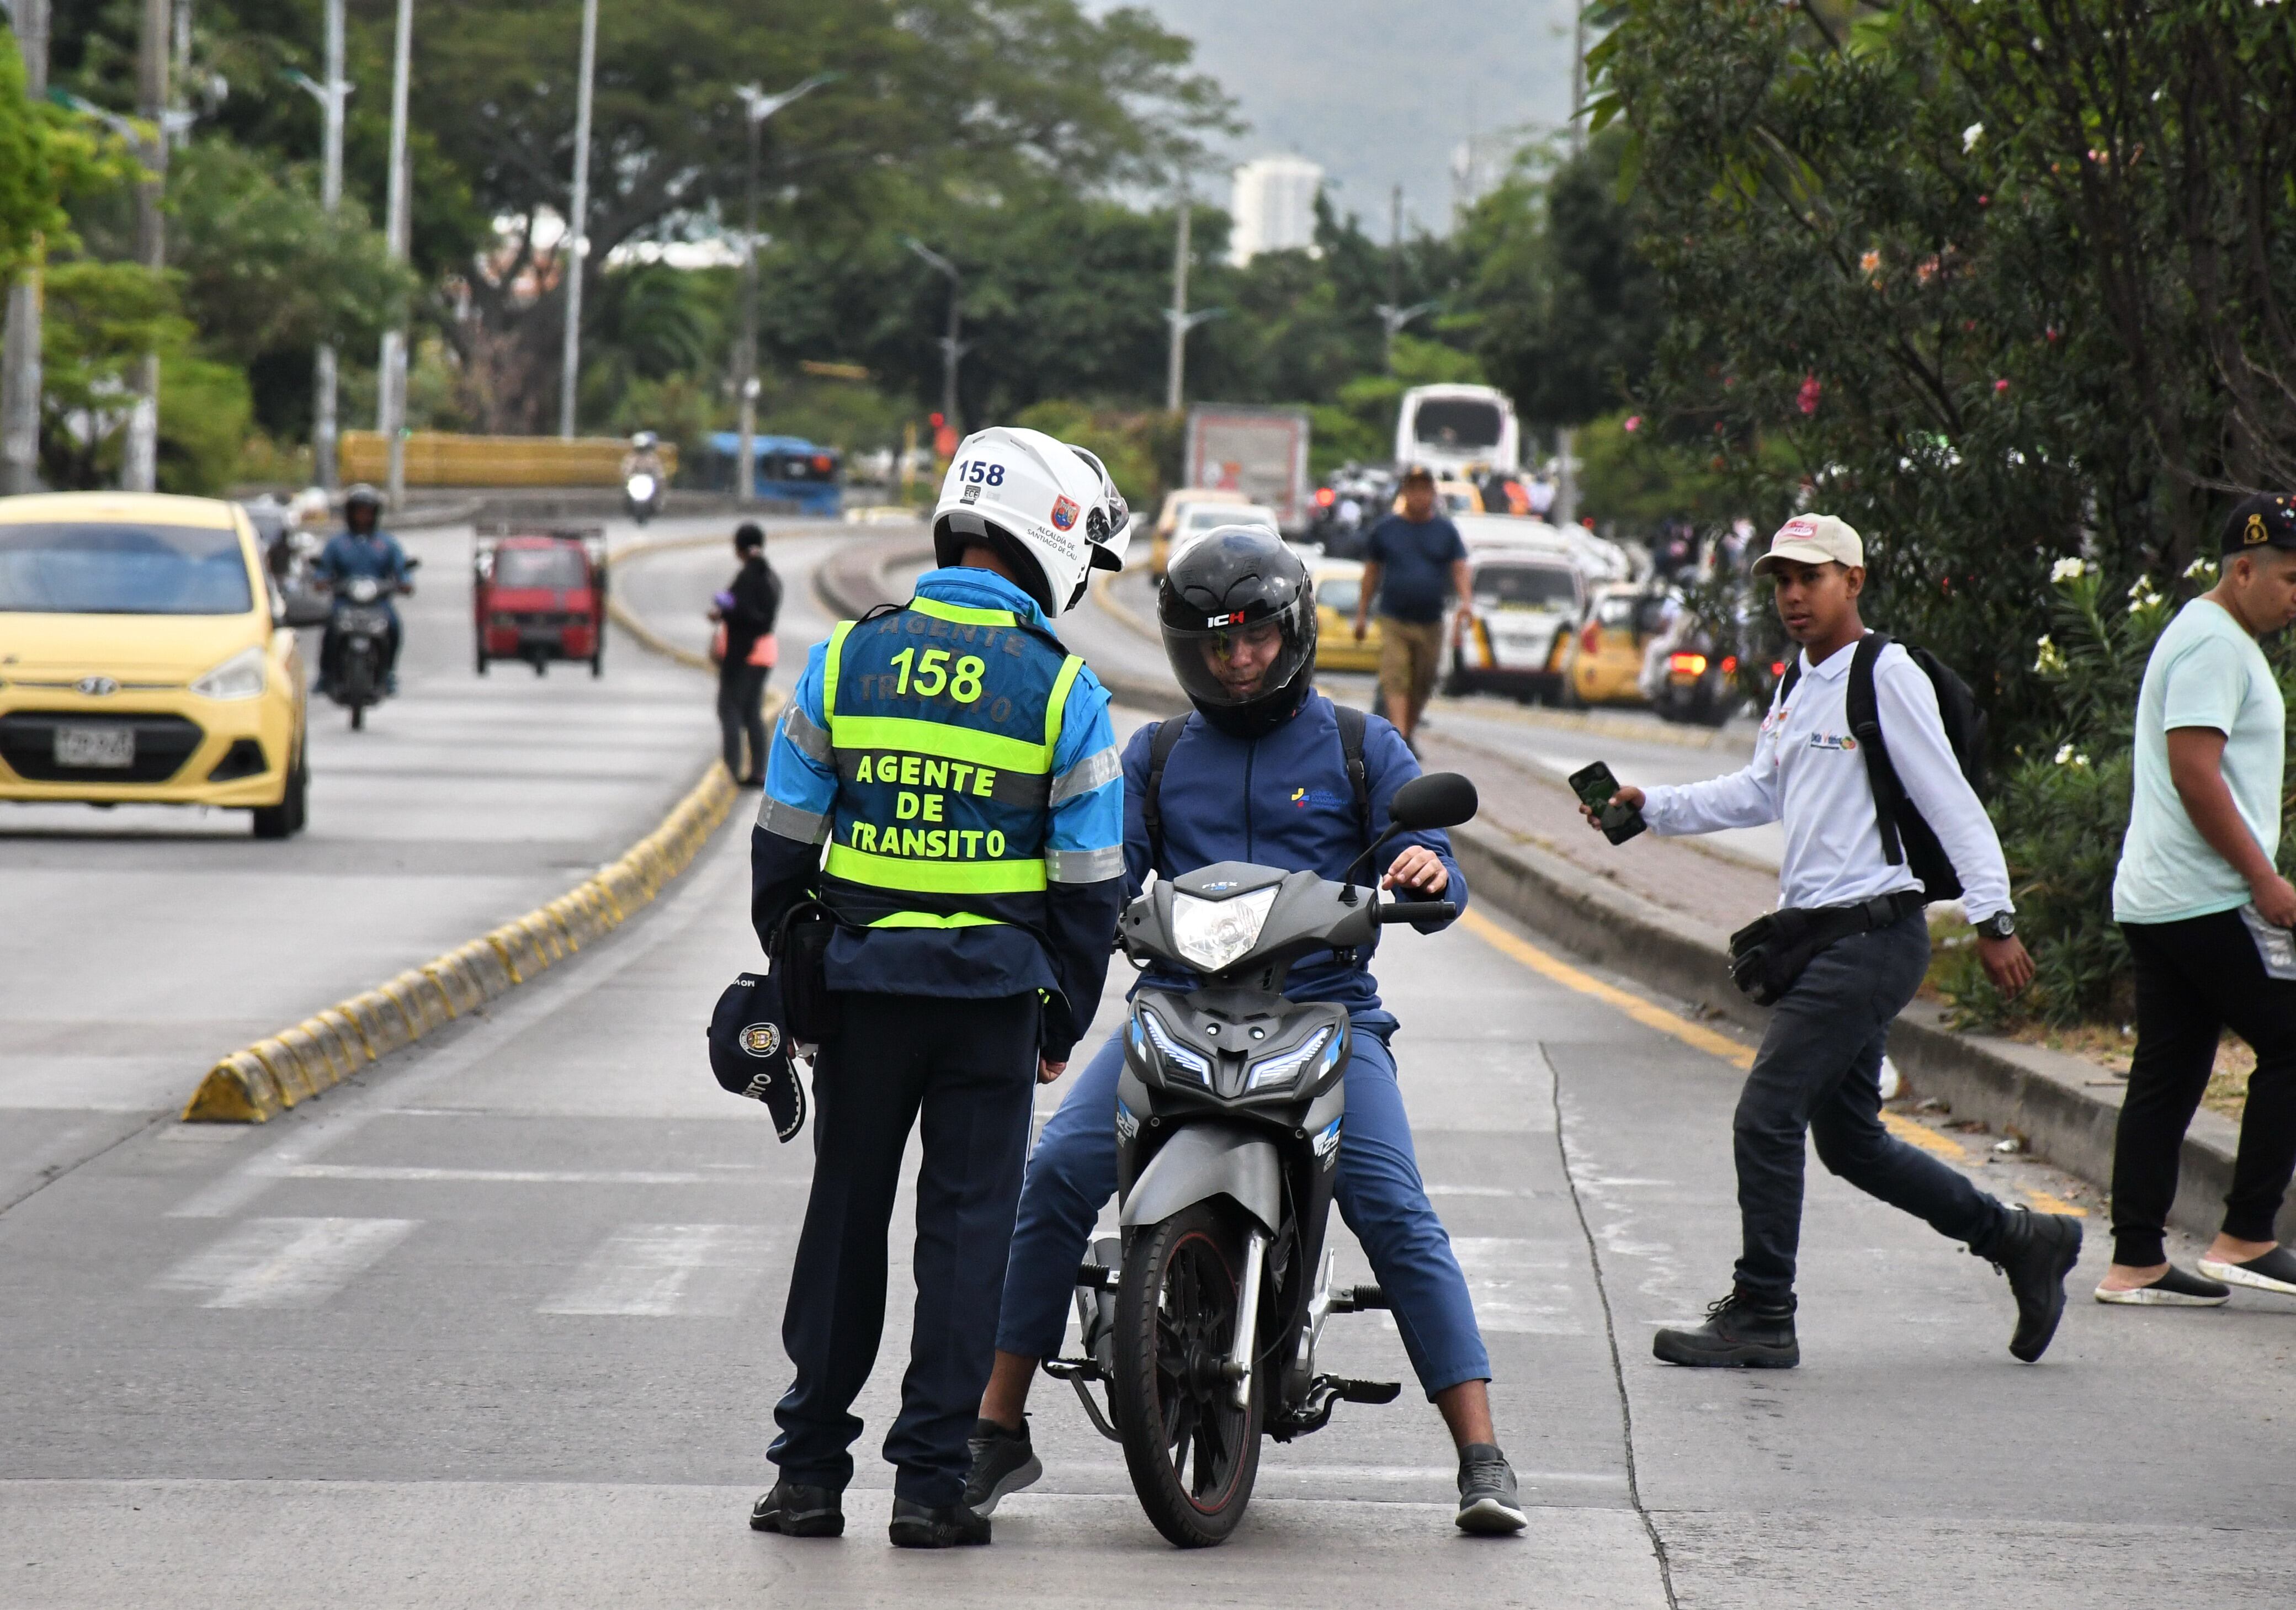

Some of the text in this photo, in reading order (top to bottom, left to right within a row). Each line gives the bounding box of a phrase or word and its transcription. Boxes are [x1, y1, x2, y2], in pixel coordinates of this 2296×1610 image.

[959, 460, 1005, 486] 158
[965, 490, 979, 498] ECE
[1027, 529, 1057, 549] SANTIAGO
[1066, 551, 1077, 561] CALI
[1037, 526, 1076, 551] ALCALDÍA DE
[1207, 610, 1244, 628] ICH
[878, 615, 1028, 657] AGENTE
[890, 647, 985, 703] 158
[856, 755, 997, 798] AGENTE
[896, 791, 944, 822] DE
[852, 820, 1006, 858] TRANSITO
[1116, 1111, 1133, 1138] 125
[1317, 1129, 1341, 1157] 125
